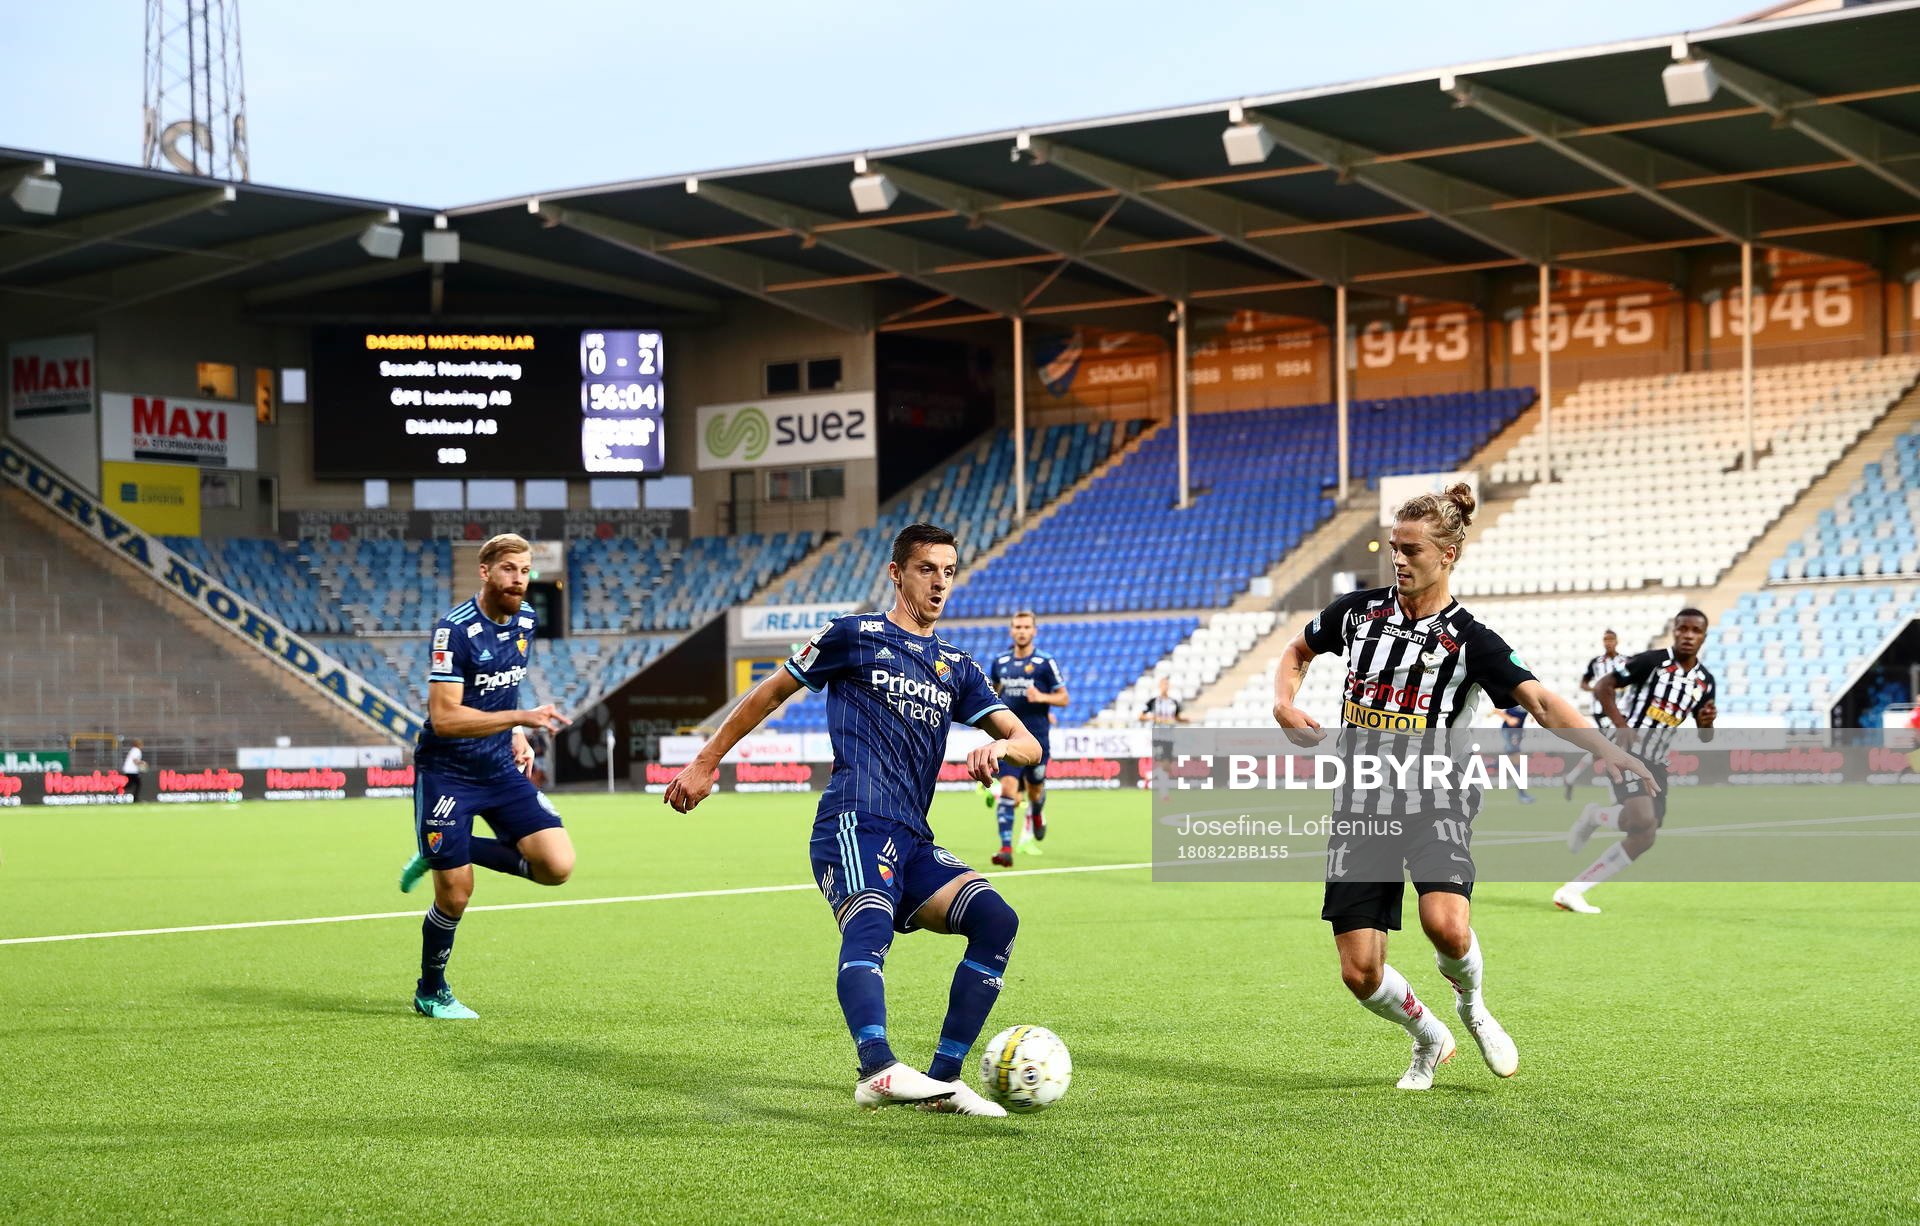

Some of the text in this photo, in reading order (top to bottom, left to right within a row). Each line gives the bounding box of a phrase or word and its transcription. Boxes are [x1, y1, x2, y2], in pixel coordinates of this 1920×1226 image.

[1702, 275, 1852, 339] 1946
[1346, 313, 1470, 370] 1943
[1505, 294, 1655, 356] 1945
[366, 334, 535, 350] DAGENS MATCHBOLLAR
[13, 355, 91, 393] MAXI
[588, 348, 606, 375] 0
[638, 348, 656, 375] 2
[1087, 360, 1157, 384] stadium
[590, 383, 656, 410] 56:04
[132, 395, 227, 441] MAXI
[0, 446, 154, 568] CURVA
[766, 612, 849, 631] REJLER
[1350, 607, 1394, 626] lincom
[1382, 624, 1428, 645] stadium
[1428, 621, 1460, 654] lincom
[871, 670, 952, 712] Prioritet
[886, 692, 942, 728] Finans
[1346, 702, 1422, 734] LINOTOL
